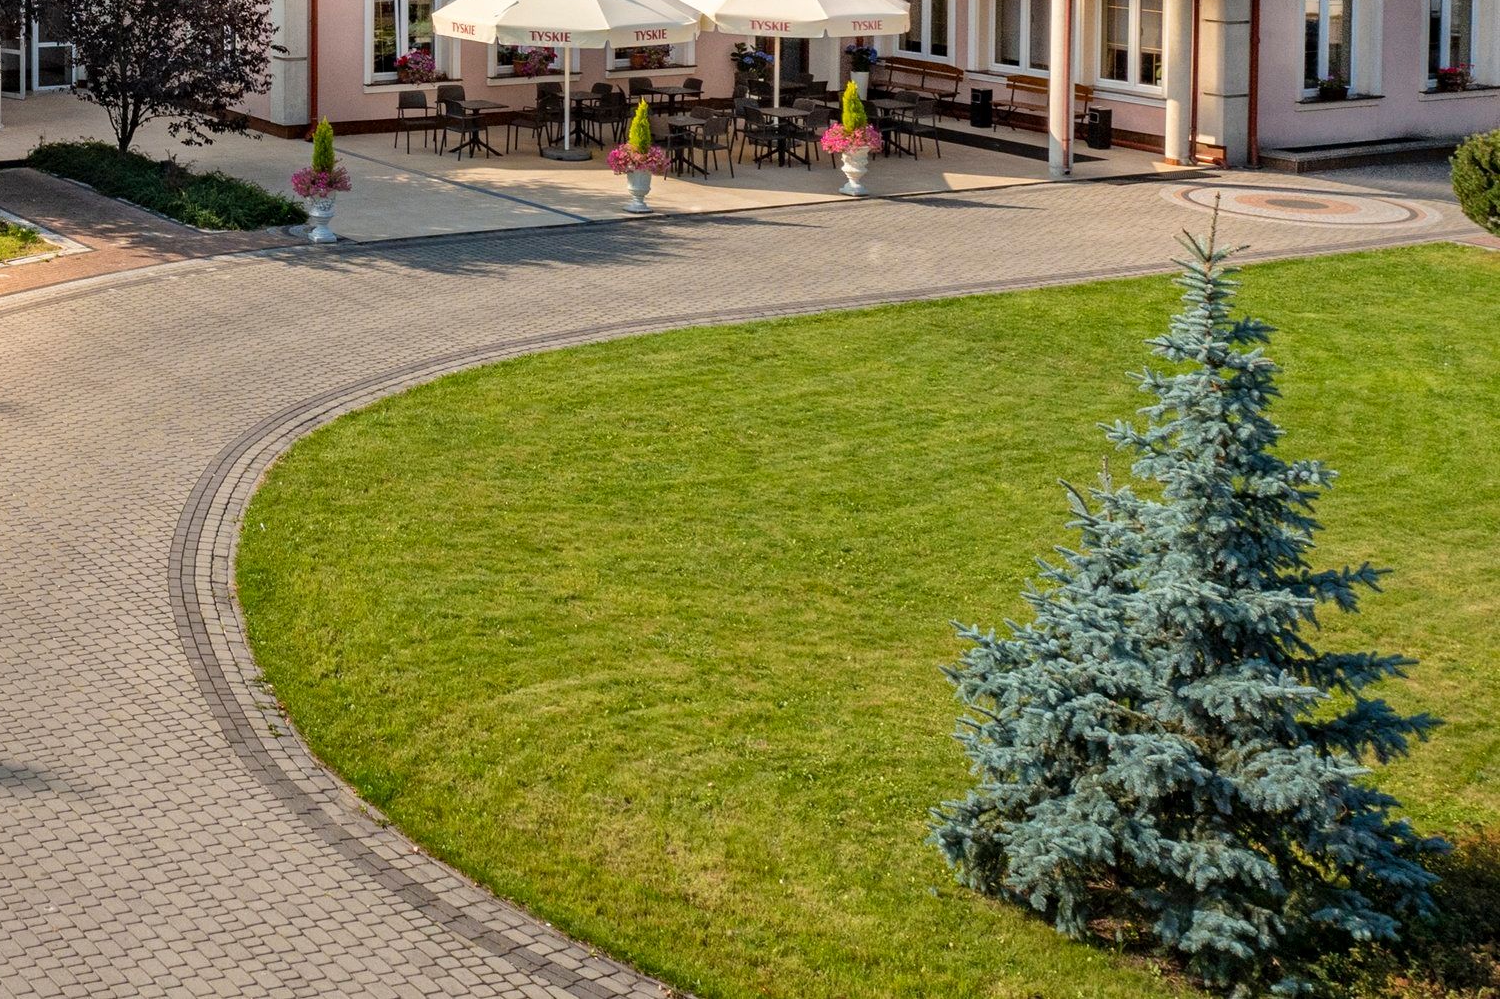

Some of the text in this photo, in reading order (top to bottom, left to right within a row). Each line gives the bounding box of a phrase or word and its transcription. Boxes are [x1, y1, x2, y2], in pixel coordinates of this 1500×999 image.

[452, 21, 476, 36] TYSKIE
[750, 20, 792, 32] TYSKIE
[851, 20, 883, 31] TYSKIE
[528, 30, 571, 43] TYSKIE
[635, 28, 667, 41] TYSKIE
